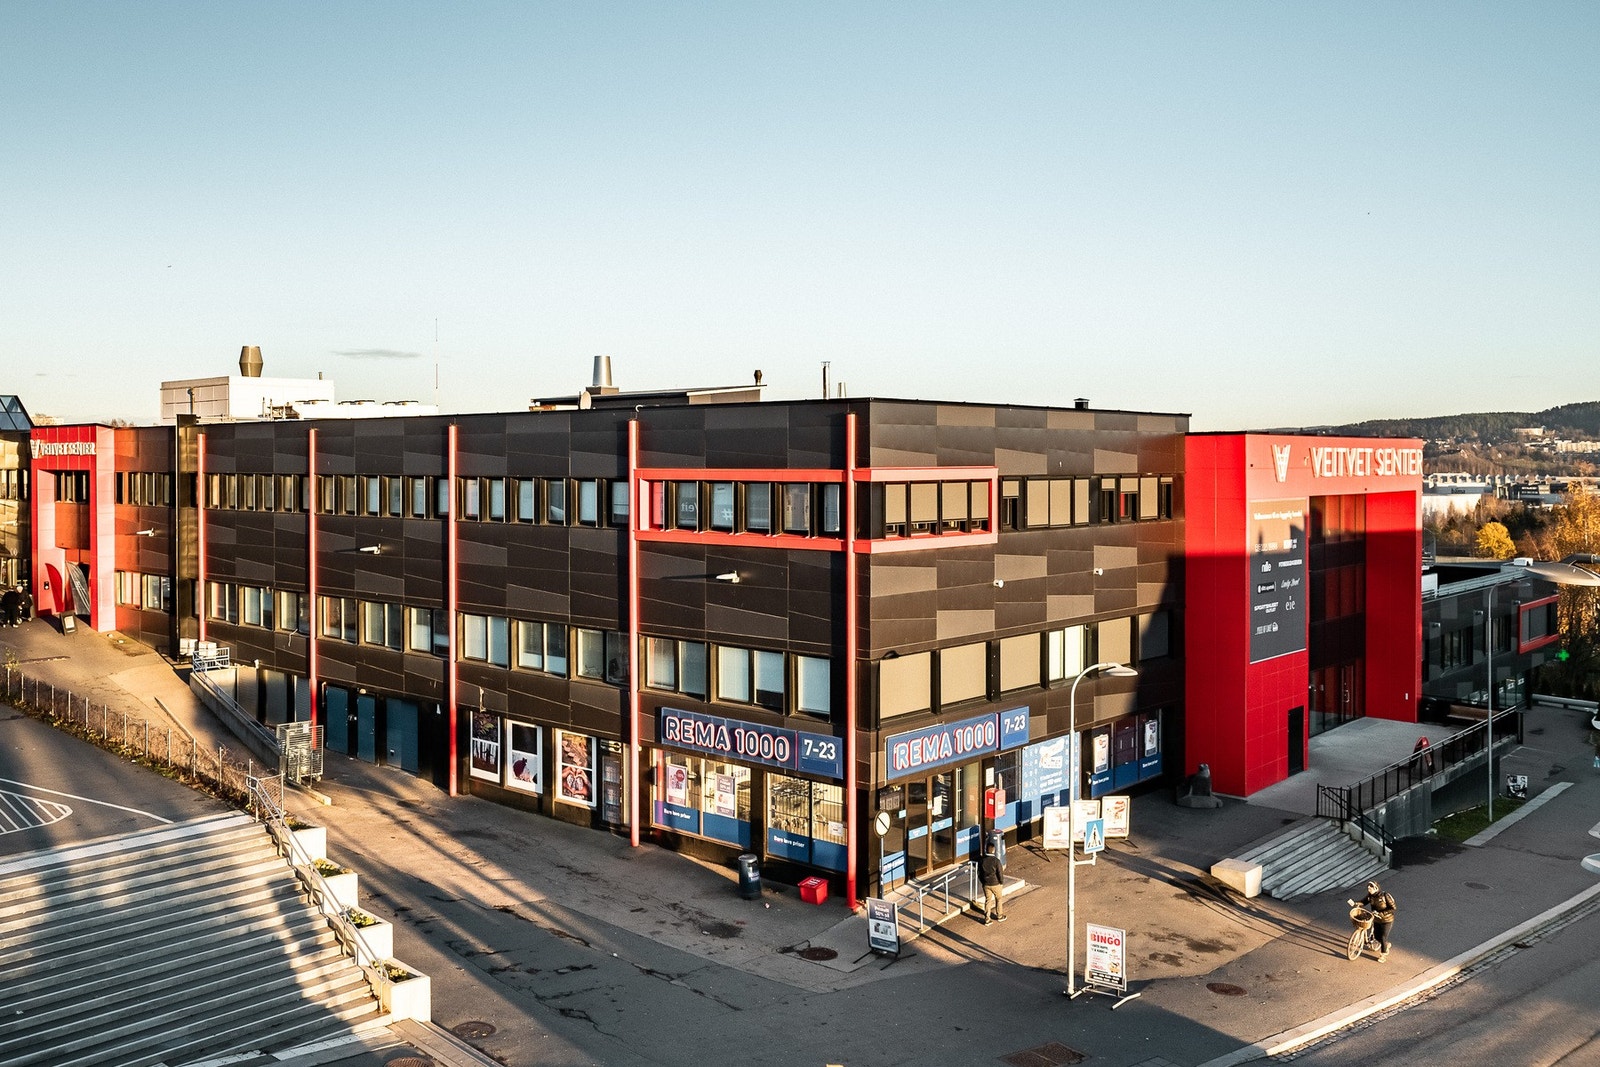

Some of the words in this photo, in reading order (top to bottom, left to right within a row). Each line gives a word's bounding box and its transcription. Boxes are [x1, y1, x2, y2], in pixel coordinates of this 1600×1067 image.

[1311, 447, 1373, 478] VEITVET
[1375, 448, 1423, 476] SENTER
[1004, 715, 1026, 734] 7-23
[666, 716, 731, 751] REMA
[735, 728, 790, 762] 1000
[804, 739, 836, 760] 7-23
[893, 732, 952, 770] REMA
[953, 721, 995, 754] 1000
[1091, 933, 1121, 946] BINGO
